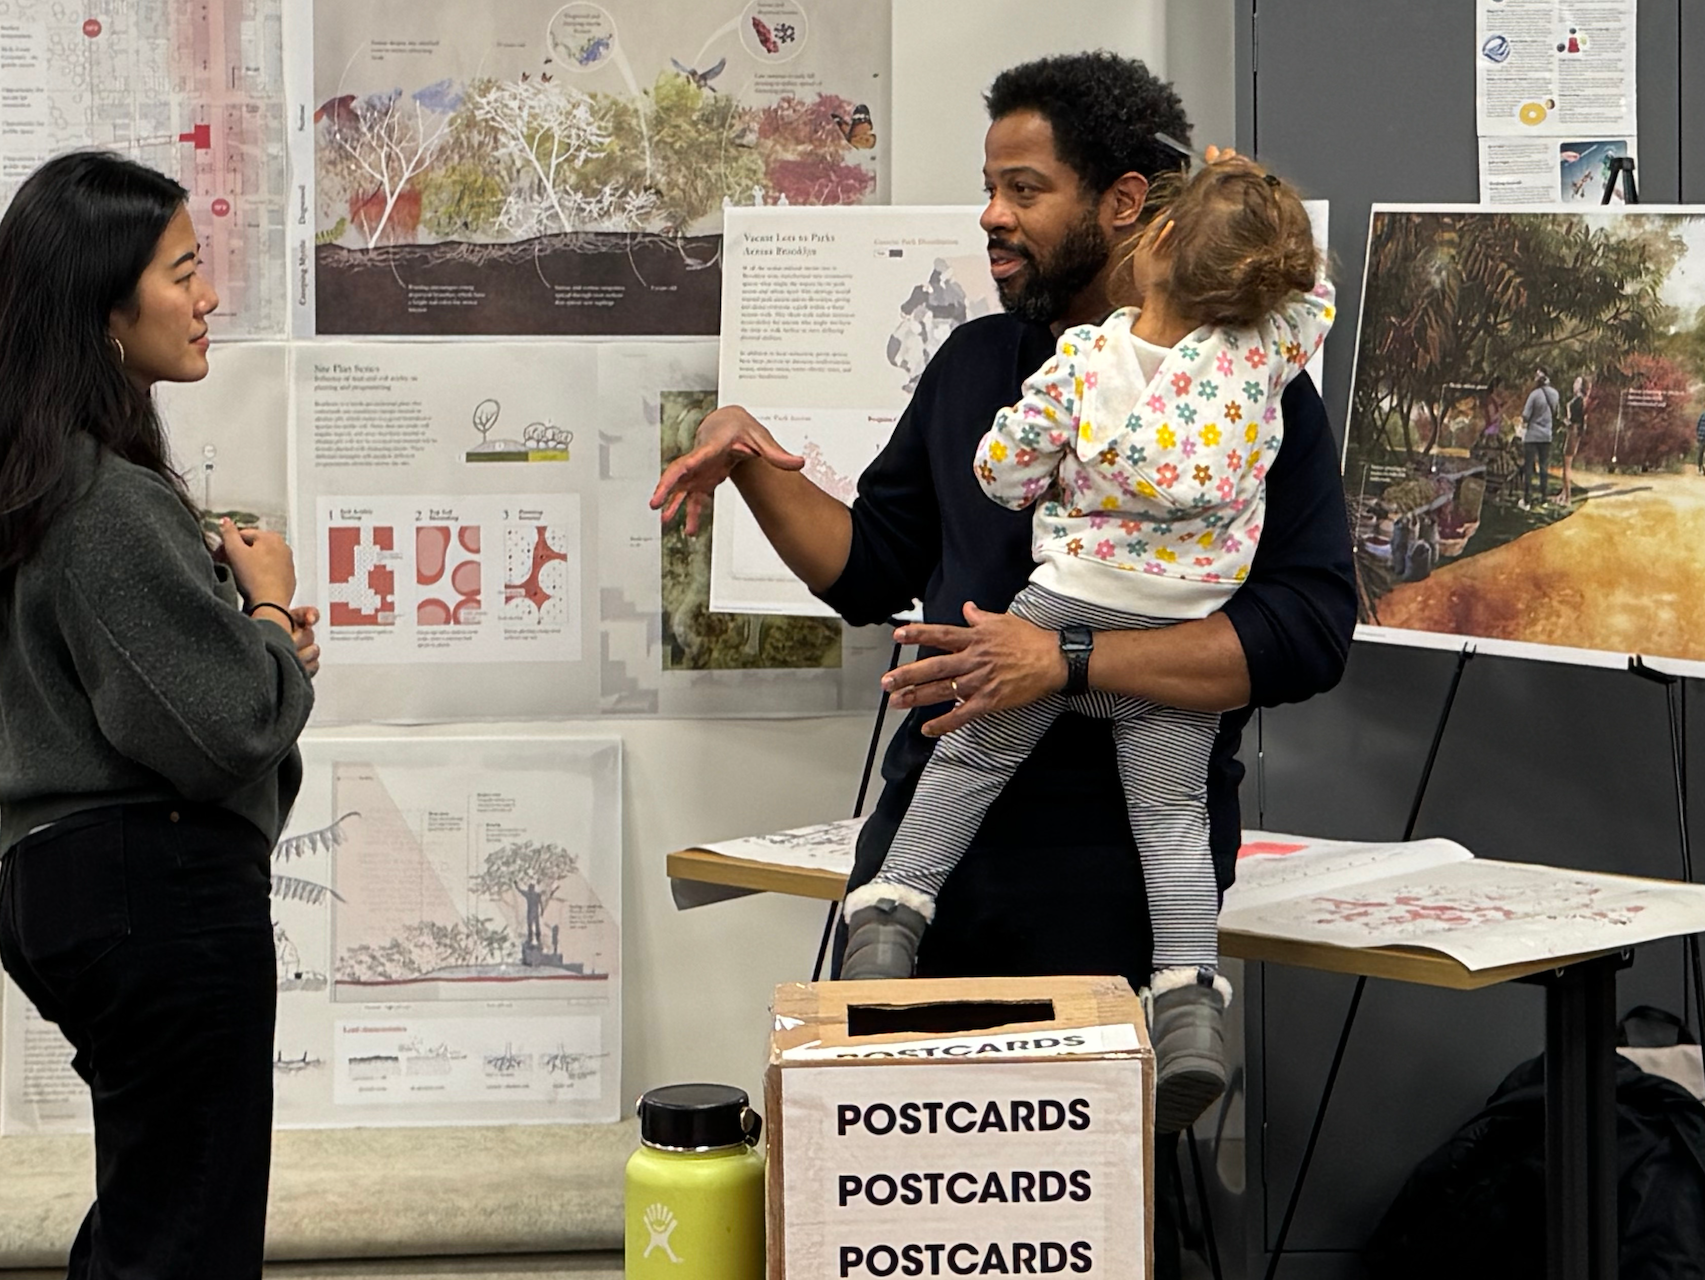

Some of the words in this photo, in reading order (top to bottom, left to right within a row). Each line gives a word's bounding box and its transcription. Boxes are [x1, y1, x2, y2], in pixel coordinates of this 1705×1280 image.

[743, 232, 773, 242] Vacant
[776, 232, 796, 242] Lots
[798, 234, 808, 242] to
[811, 232, 835, 242] Parks
[743, 246, 773, 256] Across
[775, 245, 817, 258] Brooklyn
[415, 510, 423, 522] 2
[837, 1098, 1091, 1136] POSTCARDS
[838, 1169, 1092, 1207] POSTCARDS
[839, 1240, 1093, 1278] POSTCARDS
